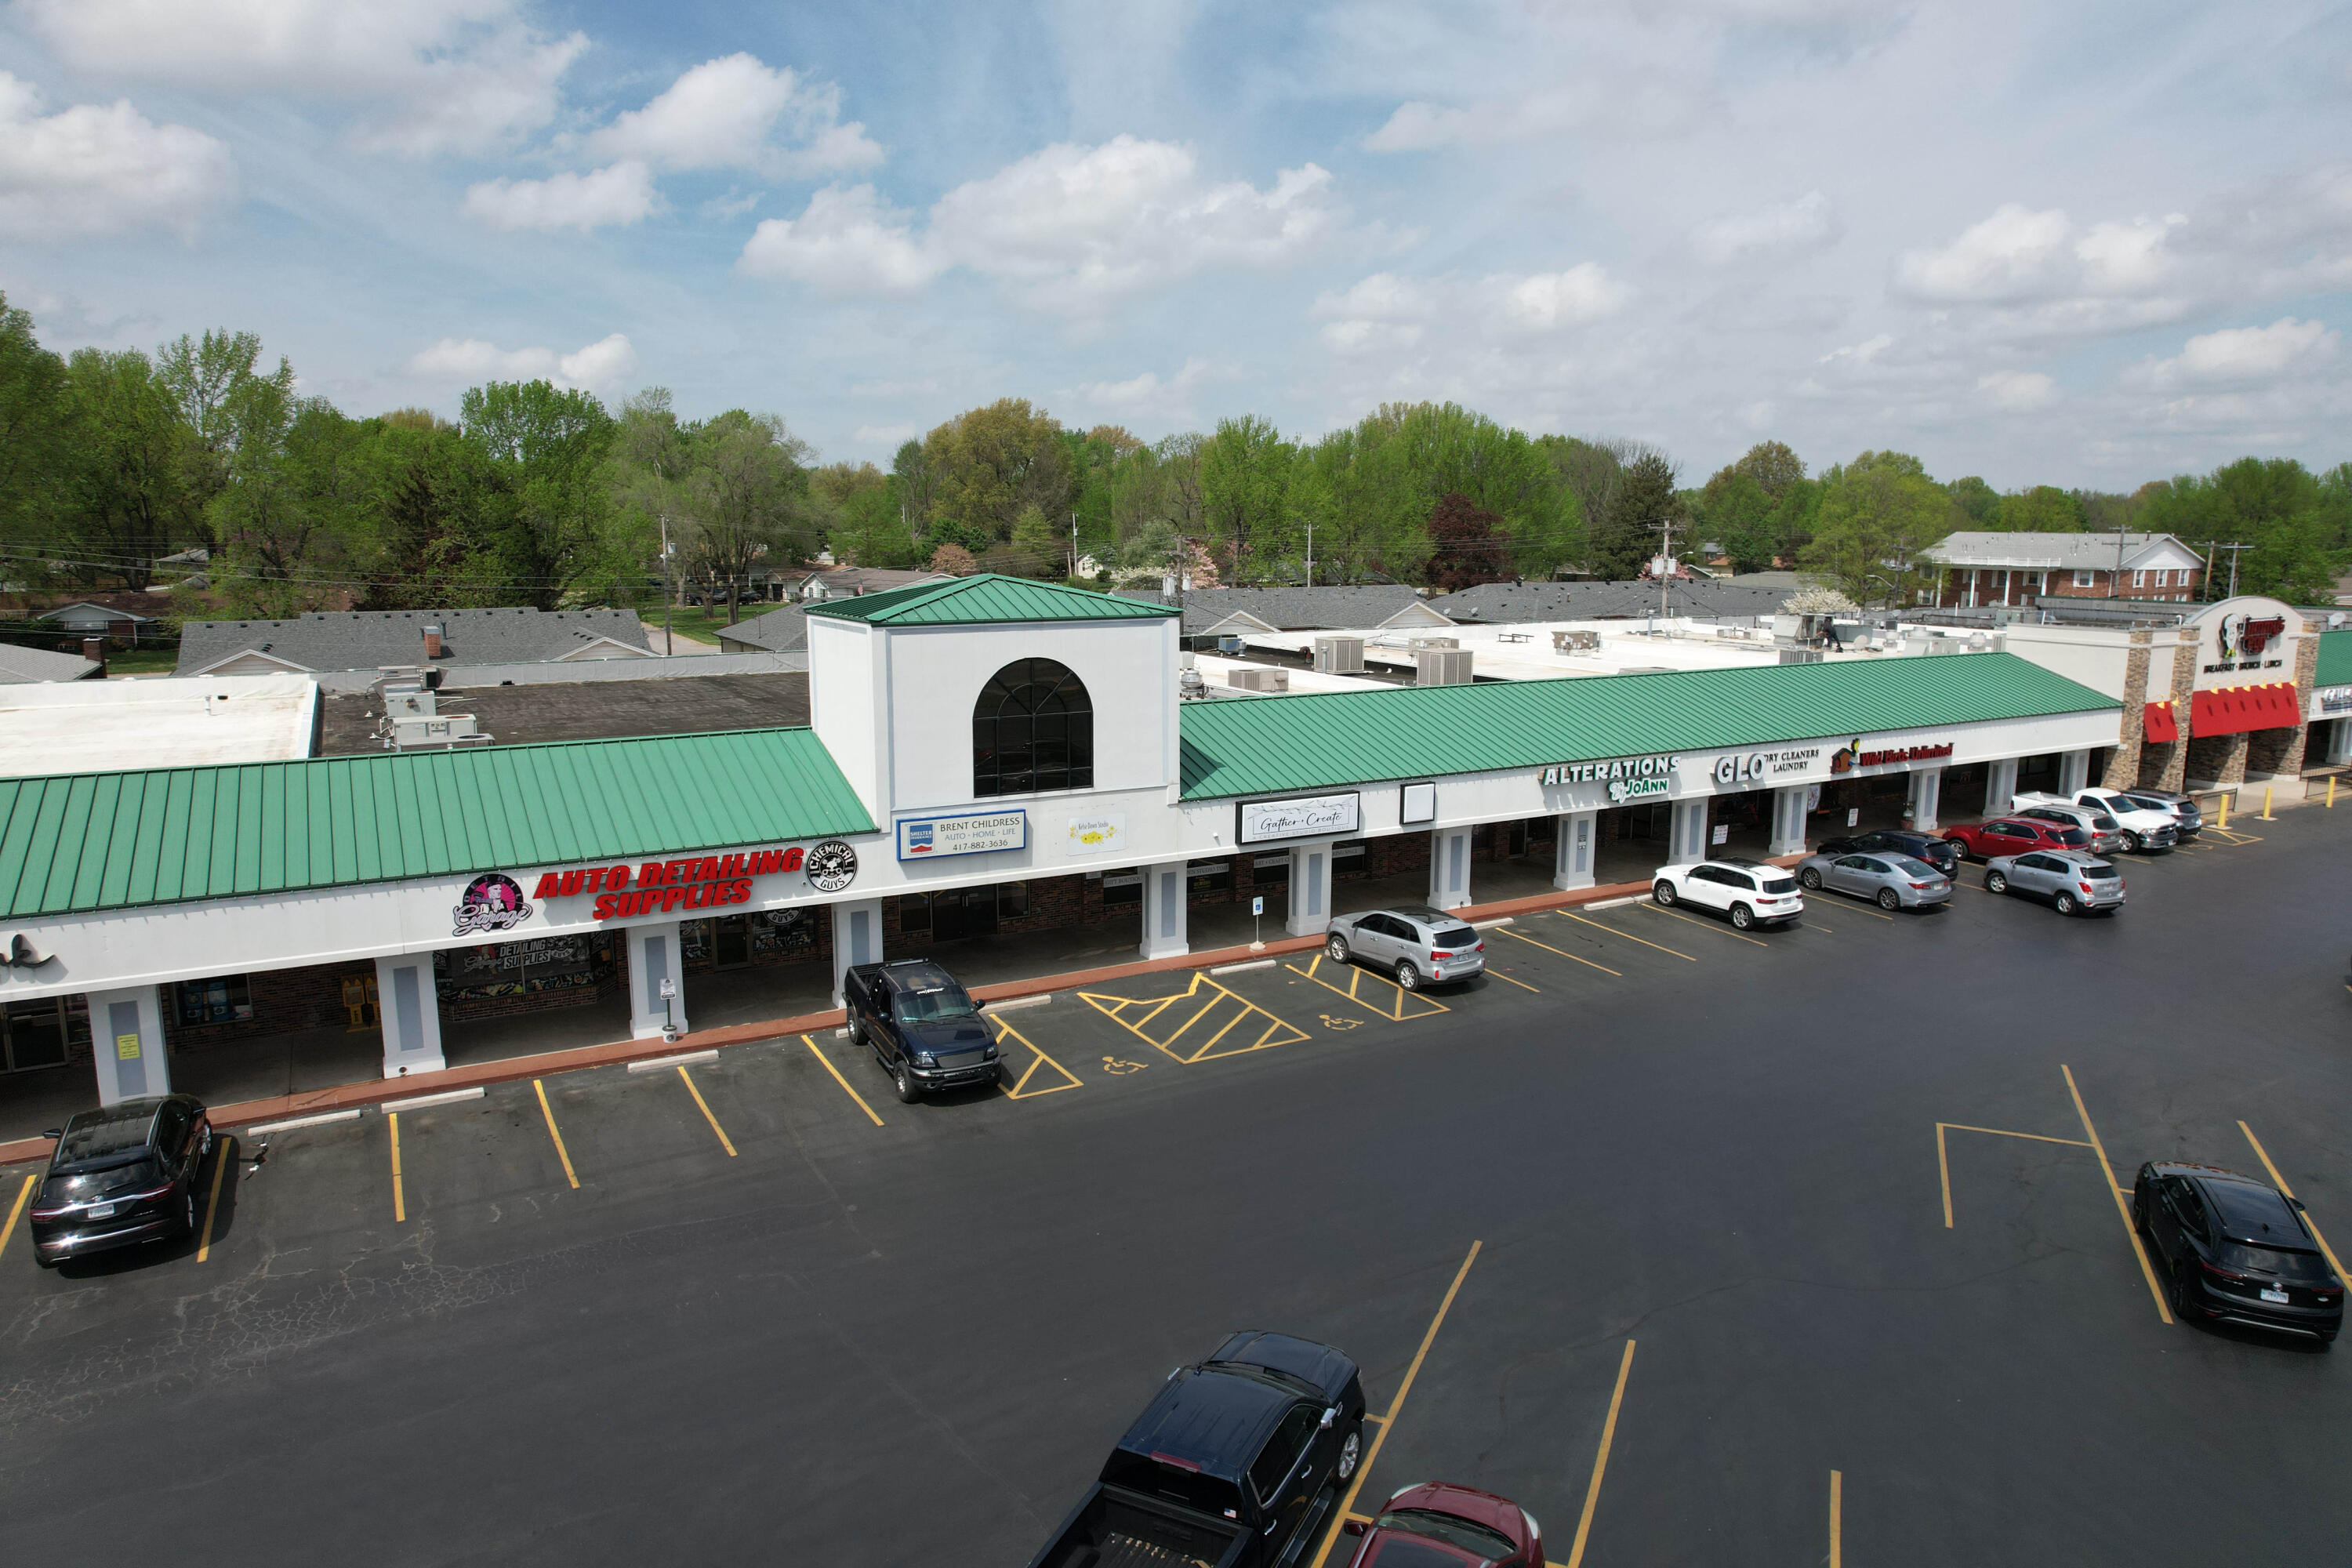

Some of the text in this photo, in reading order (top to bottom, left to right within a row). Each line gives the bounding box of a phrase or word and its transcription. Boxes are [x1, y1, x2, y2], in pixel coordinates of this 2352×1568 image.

[2264, 659, 2282, 669] LUNCH
[1781, 750, 1820, 760] CLEANERS
[1860, 742, 1955, 766] Wild Birds Unlimited
[1543, 756, 1682, 785] ALTERATIONS
[1715, 753, 1767, 784] GLO
[1773, 761, 1809, 772] LAUNDRY
[940, 817, 1020, 832] BRENT CHILDRESS
[1261, 811, 1343, 832] Gather Create
[972, 829, 995, 838] HOME
[953, 839, 1008, 851] 417-882-3636
[810, 844, 854, 869] CHEMICAL
[533, 848, 804, 899] AUTO DETAILING
[463, 876, 521, 903] DETAIL
[820, 877, 844, 889] GUYS
[593, 878, 753, 920] SUPPLIES
[452, 902, 533, 936] Garage
[772, 913, 794, 922] GUYS
[500, 939, 546, 957] DETAILING
[506, 951, 549, 968] SUPPLIES
